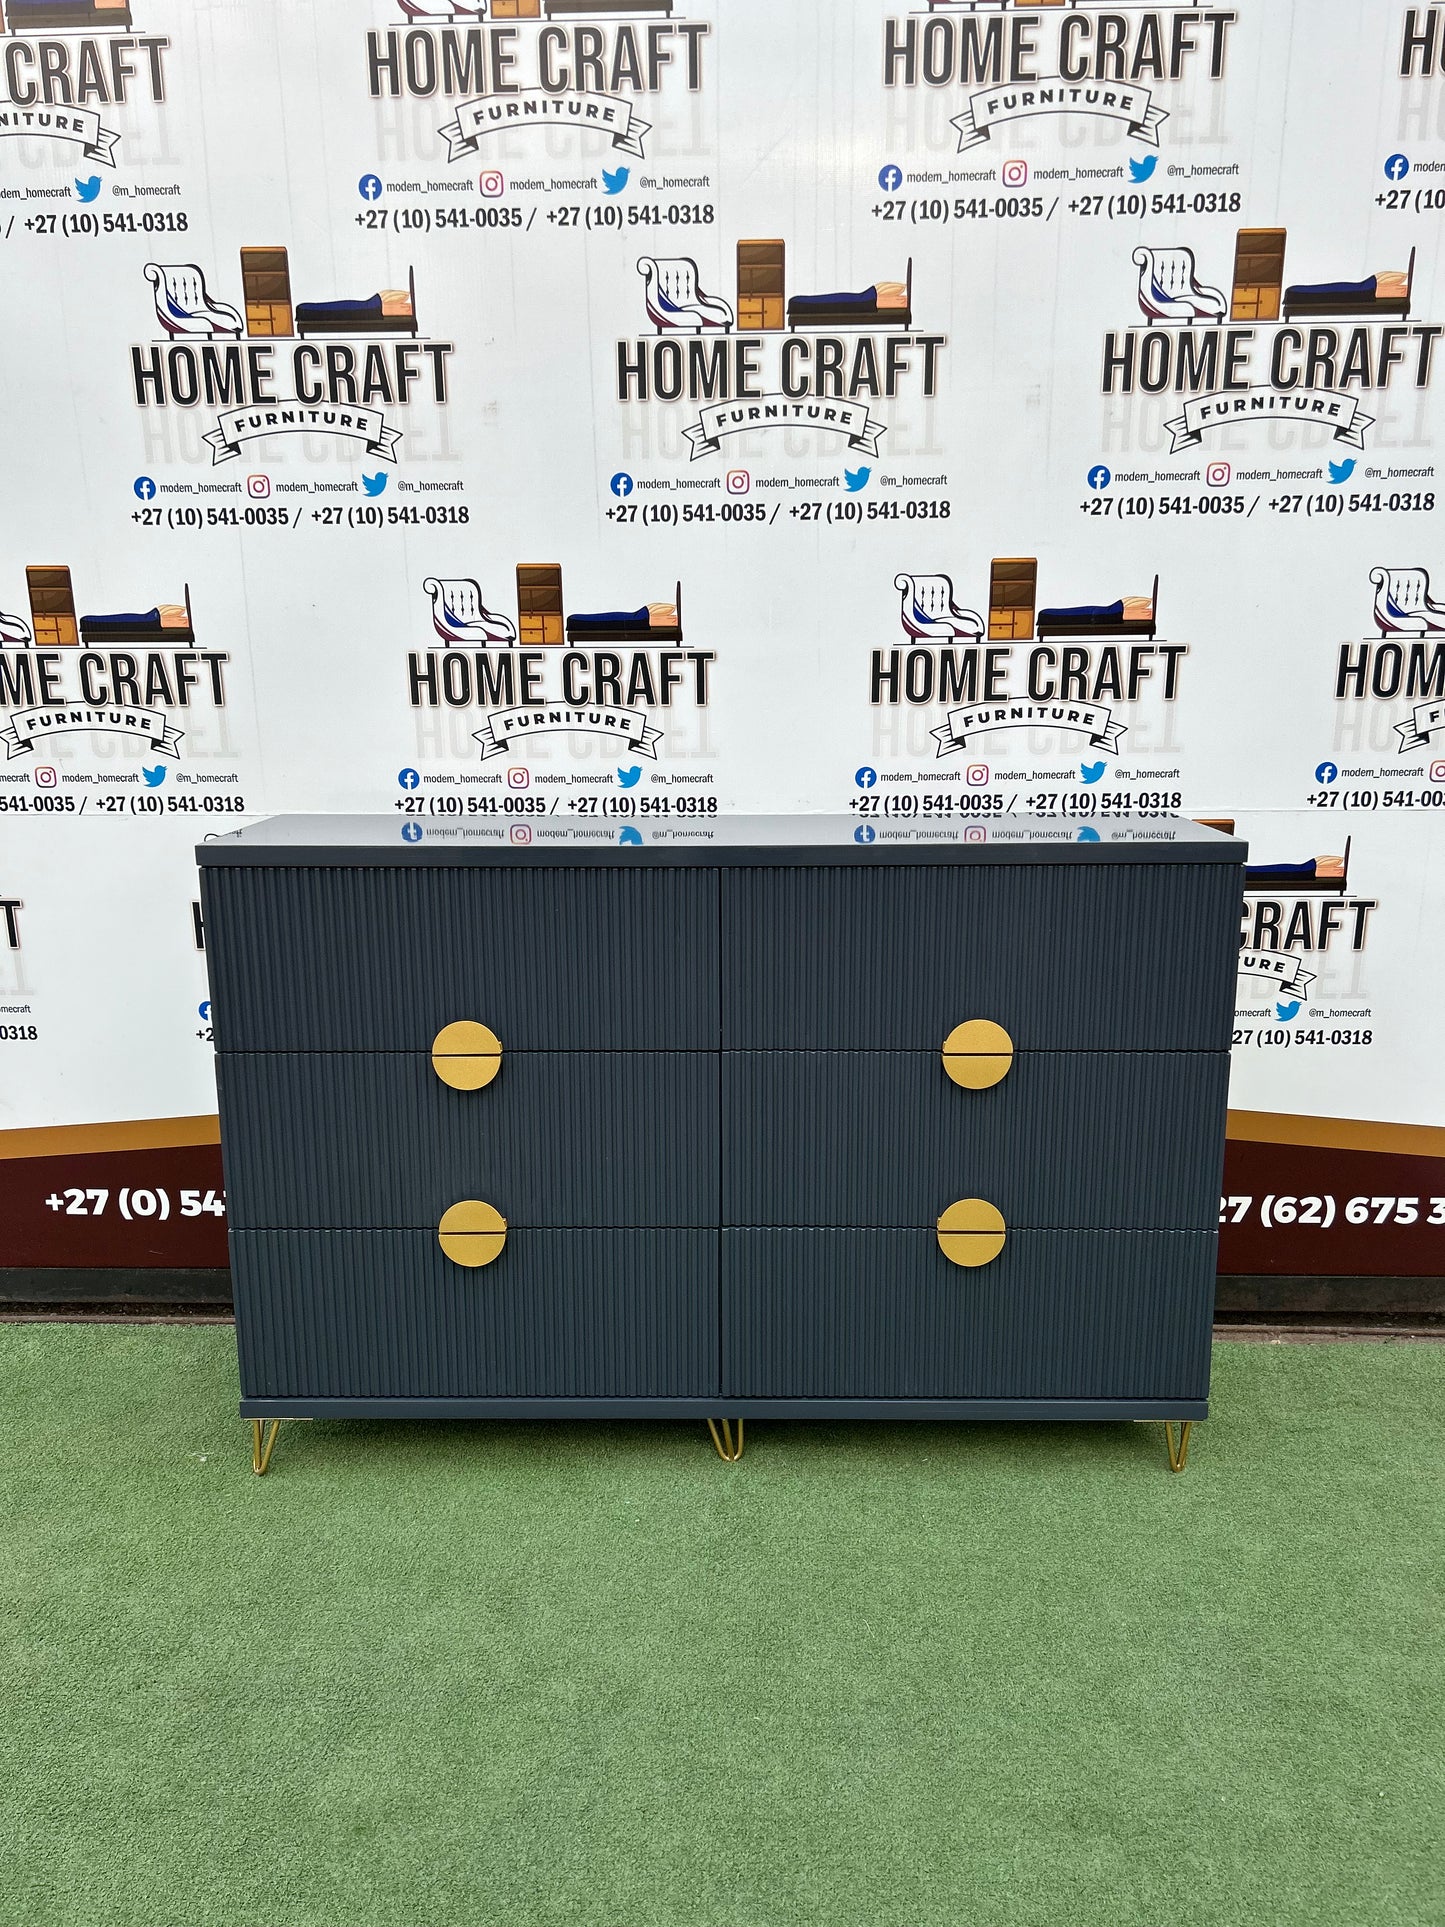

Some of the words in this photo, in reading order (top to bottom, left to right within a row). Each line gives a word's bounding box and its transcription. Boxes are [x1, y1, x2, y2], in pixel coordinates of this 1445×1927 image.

[368, 29, 518, 95] HOME
[539, 24, 707, 92] CRAFT
[885, 17, 1038, 84] HOME
[1060, 13, 1234, 81] CRAFT
[6, 38, 167, 105] CRAFT
[473, 100, 615, 125] FURNITURE
[987, 89, 1133, 115] FURNITURE
[640, 175, 710, 190] @m_homecraft
[1167, 163, 1239, 178] @m_homecraft
[112, 184, 181, 198] @m_homecraft
[1375, 190, 1411, 209] +27
[355, 210, 388, 228] +27
[394, 209, 430, 233] (10)
[436, 208, 522, 228] 541-0035
[547, 207, 580, 226] +27
[586, 206, 622, 230] (10)
[628, 205, 714, 225] 541-0318
[872, 201, 906, 220] +27
[911, 200, 948, 224] (10)
[954, 198, 1042, 218] 541-0035
[1068, 196, 1103, 215] +27
[1108, 195, 1146, 219] (10)
[1152, 193, 1240, 214] 541-0318
[25, 215, 56, 233] +27
[62, 214, 99, 237] (10)
[103, 212, 188, 232] 541-0318
[618, 340, 763, 399] HOME
[782, 337, 944, 397] CRAFT
[1103, 330, 1253, 392] HOME
[1271, 327, 1442, 389] CRAFT
[132, 346, 276, 405] HOME
[294, 344, 451, 404] CRAFT
[716, 404, 852, 427] FURNITURE
[1200, 396, 1341, 420] FURNITURE
[234, 410, 368, 433] FURNITURE
[880, 474, 947, 488] @m_homecraft
[1365, 466, 1434, 480] @m_homecraft
[398, 480, 464, 493] @m_homecraft
[132, 508, 162, 525] +27
[168, 508, 202, 529] (10)
[208, 508, 288, 525] 541-0035
[312, 507, 342, 524] +27
[348, 507, 383, 528] (10)
[388, 506, 469, 524] 541-0318
[606, 505, 637, 522] +27
[643, 505, 678, 526] (10)
[683, 504, 766, 522] 541-0035
[790, 503, 822, 520] +27
[827, 502, 862, 524] (10)
[867, 501, 950, 519] 541-0318
[1080, 498, 1113, 516] +27
[1118, 497, 1154, 519] (10)
[1159, 496, 1244, 515] 541-0035
[1269, 496, 1302, 512] +27
[1307, 495, 1344, 516] (10)
[1348, 493, 1434, 512] 541-0318
[79, 653, 227, 705] CRAFT
[408, 653, 544, 705] HOME
[563, 652, 713, 705] CRAFT
[871, 648, 1010, 703] HOME
[1028, 646, 1186, 701] CRAFT
[26, 706, 151, 731] FURNITURE
[503, 706, 631, 731] FURNITURE
[963, 702, 1095, 728] FURNITURE
[176, 773, 239, 784] @m_homecraft
[651, 774, 714, 785] @m_homecraft
[1115, 768, 1180, 780] @m_homecraft
[0, 796, 75, 812] 541-0035
[96, 796, 125, 812] +27
[131, 796, 163, 815] (10)
[168, 796, 244, 812] 541-0318
[395, 797, 424, 812] +27
[430, 797, 463, 814] (10)
[468, 797, 546, 812] 541-0035
[568, 797, 597, 812] +27
[603, 797, 636, 814] (10)
[640, 797, 717, 812] 541-0318
[849, 796, 880, 811] +27
[885, 795, 918, 814] (10)
[923, 794, 1003, 810] 541-0035
[1026, 794, 1058, 809] +27
[1062, 793, 1096, 811] (10)
[1101, 792, 1181, 808] 541-0318
[1307, 791, 1339, 807] +27
[1343, 791, 1378, 811] (10)
[1383, 790, 1445, 807] 541-00
[1309, 1008, 1371, 1019] @m_homecraft
[1257, 1030, 1290, 1048] (10)
[1295, 1030, 1373, 1045] 541-0318
[45, 1188, 109, 1215] +27
[119, 1188, 170, 1220] (0)
[180, 1190, 226, 1217] 54
[1261, 1195, 1336, 1228] (62)
[1345, 1197, 1418, 1224] 675
